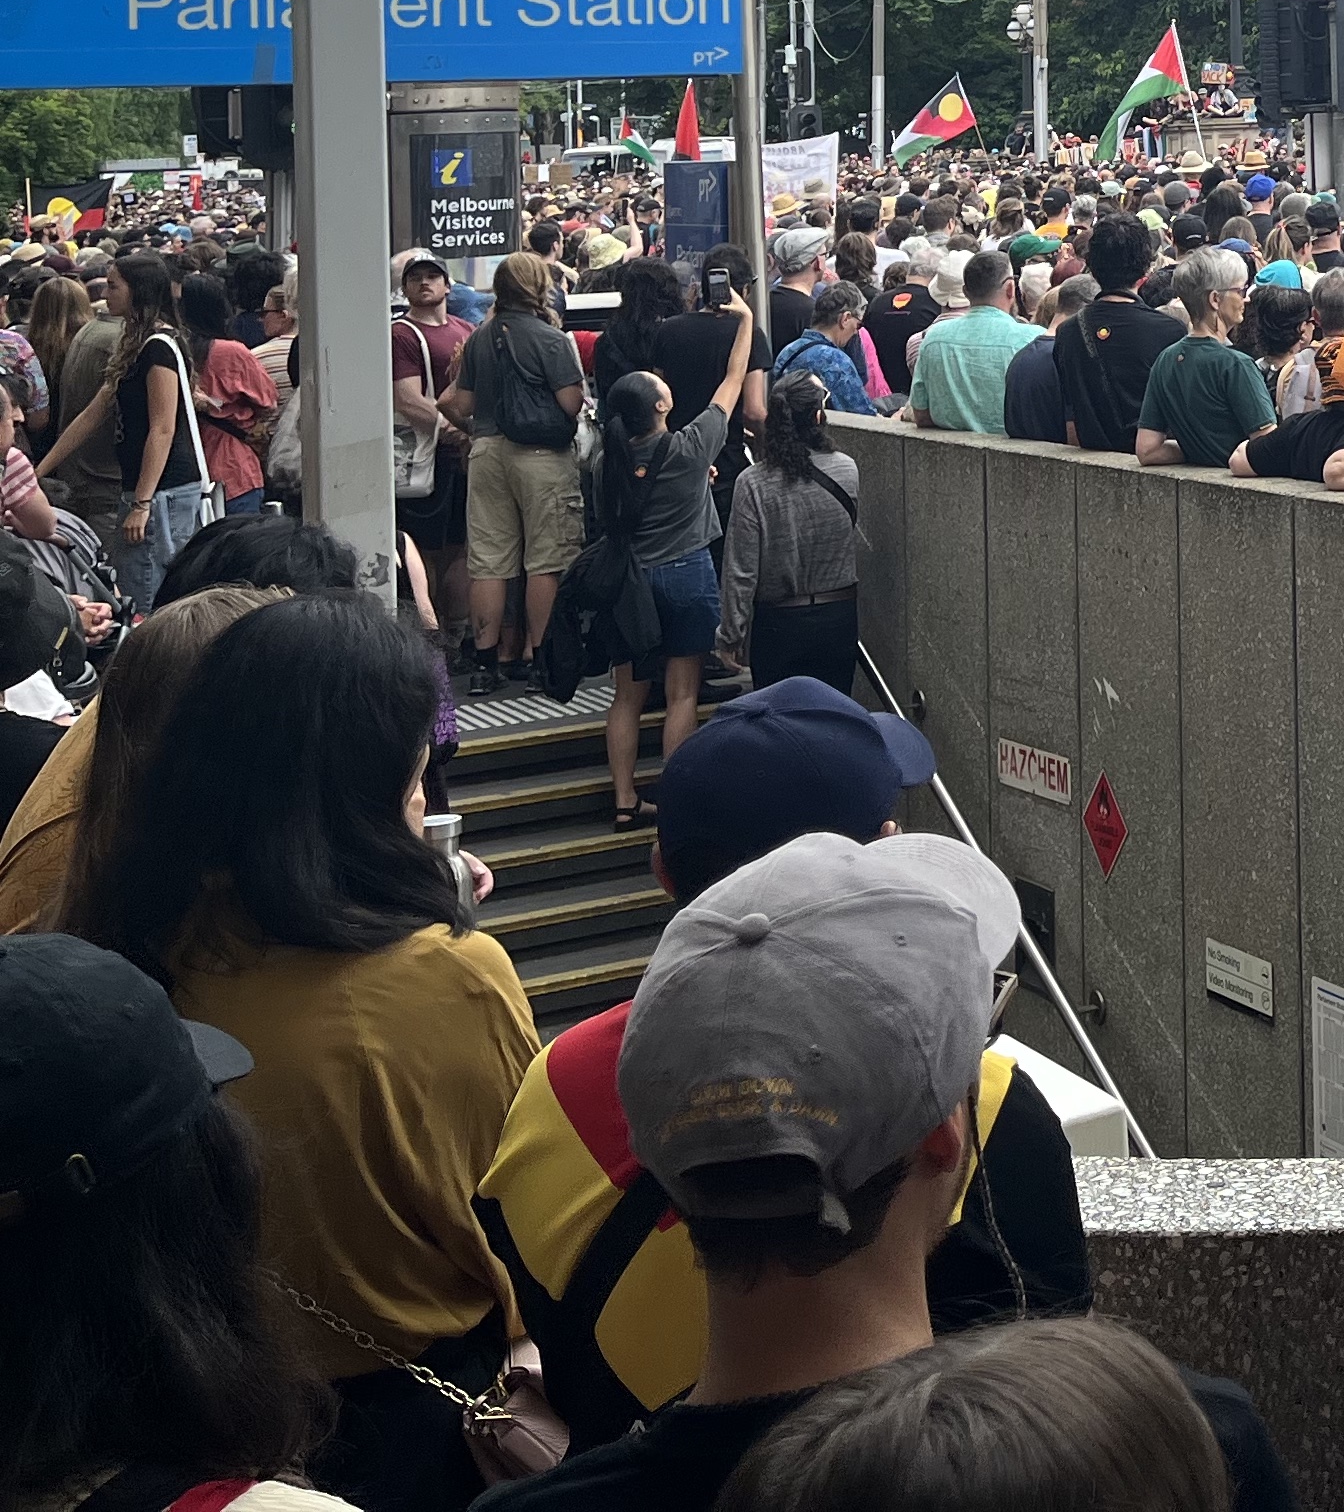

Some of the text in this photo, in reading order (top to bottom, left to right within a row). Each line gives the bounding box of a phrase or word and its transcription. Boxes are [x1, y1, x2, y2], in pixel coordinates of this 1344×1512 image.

[430, 196, 515, 214] Melbourne
[430, 214, 493, 230] Visitor
[431, 230, 506, 248] Services
[999, 742, 1068, 795] HAZCHEM
[1207, 946, 1241, 972] No Smoking
